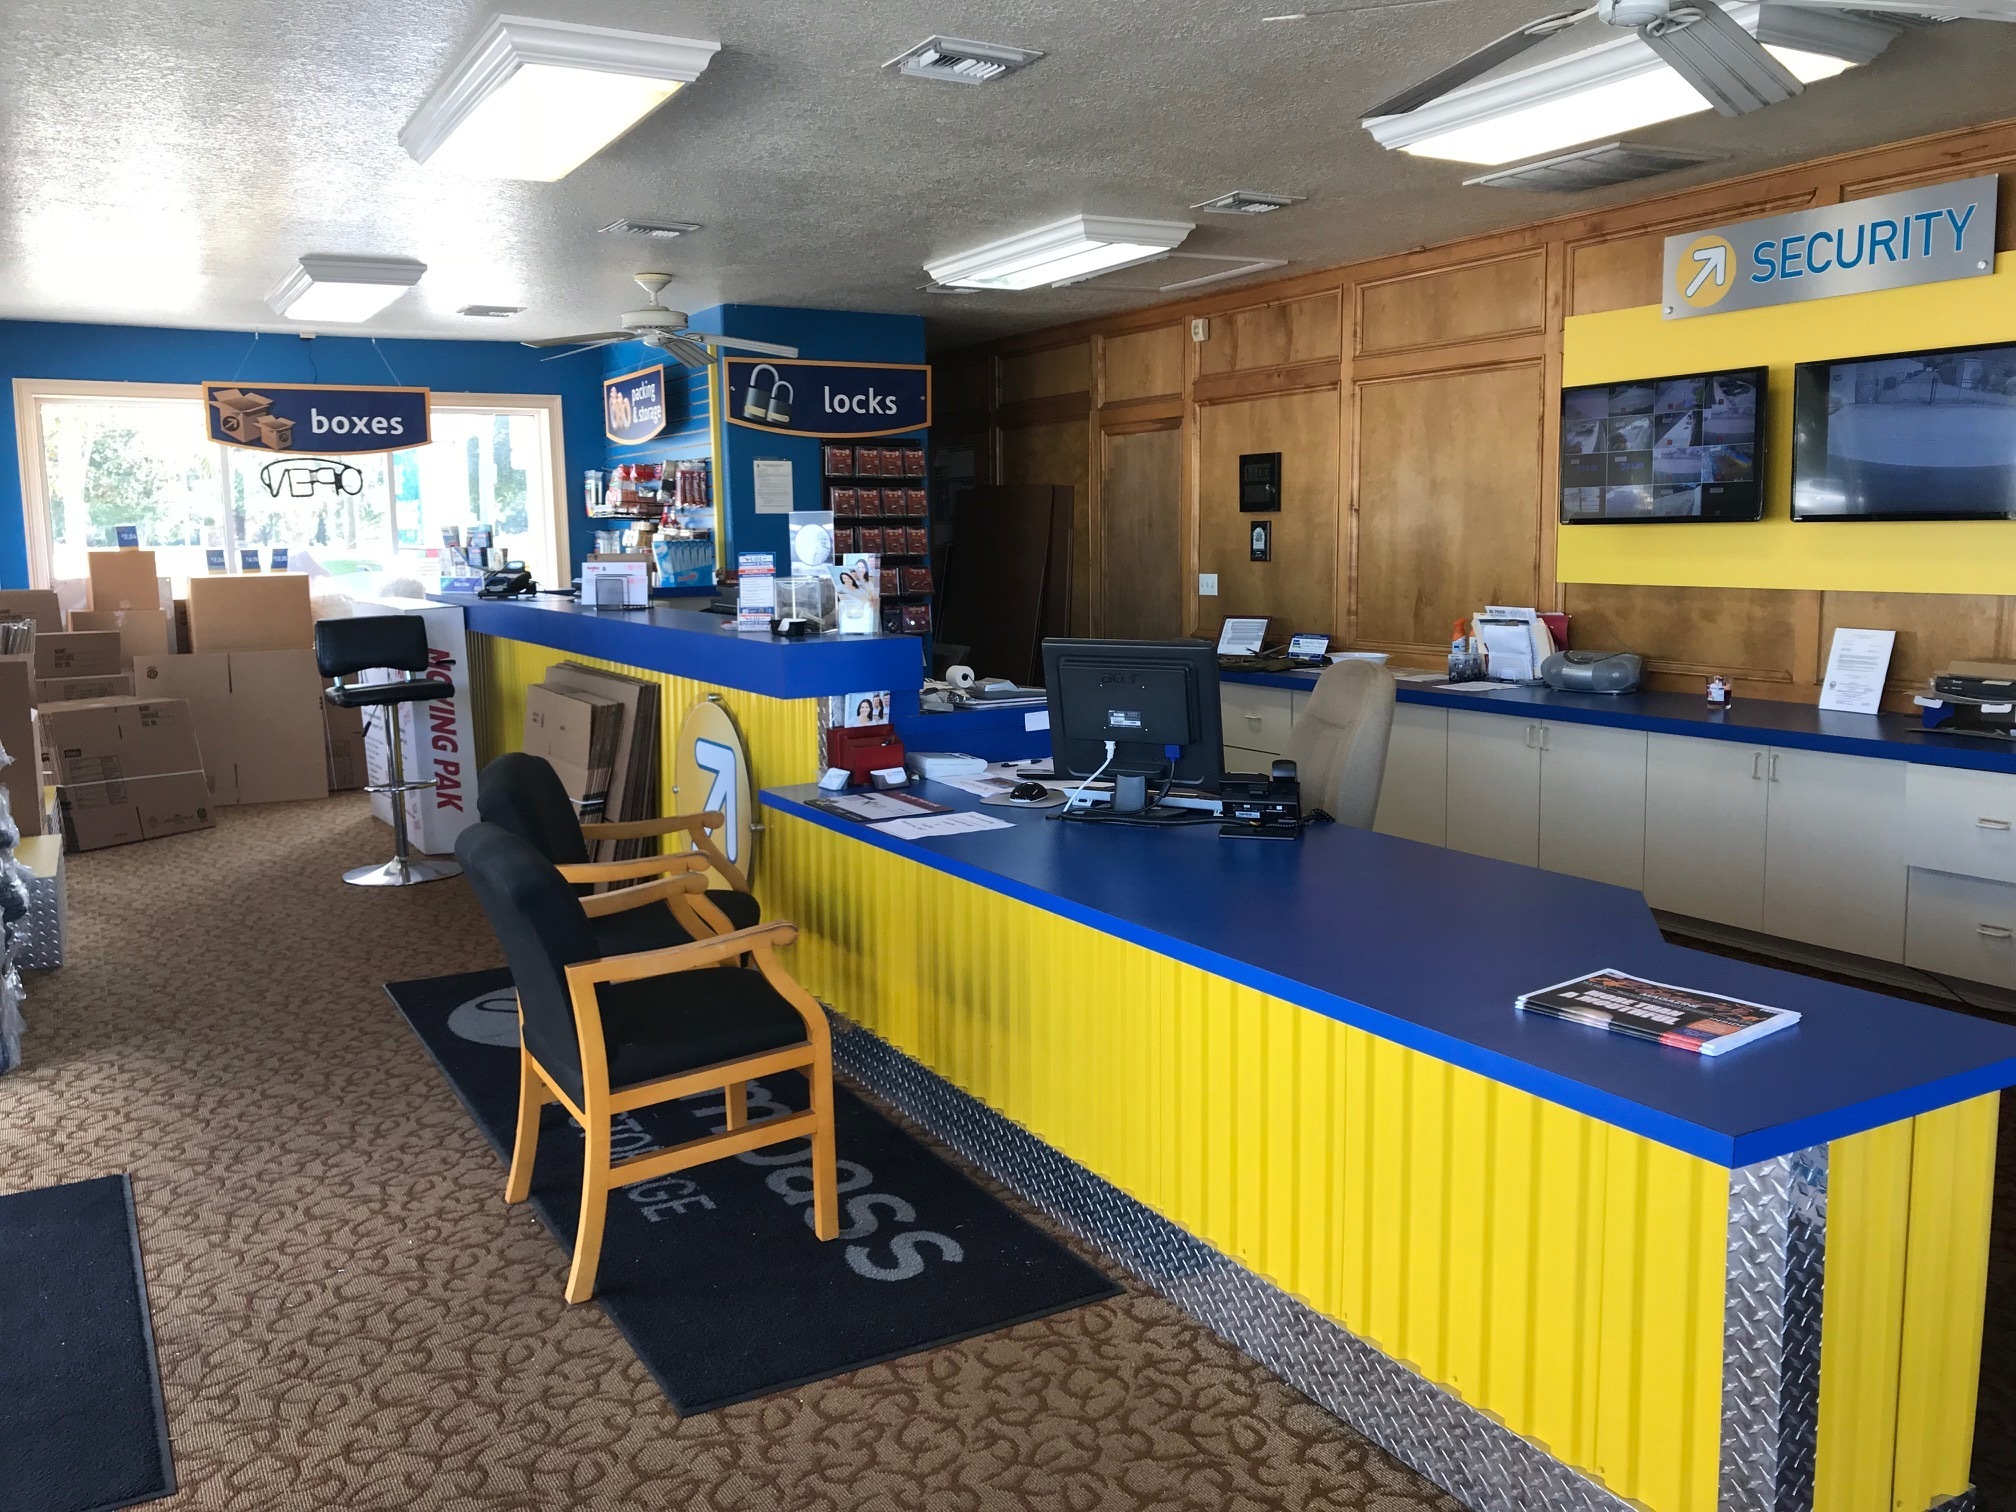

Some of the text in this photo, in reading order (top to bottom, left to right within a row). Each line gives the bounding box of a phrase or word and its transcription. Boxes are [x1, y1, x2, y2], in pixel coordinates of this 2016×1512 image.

[1749, 202, 1979, 284] SECURITY
[631, 380, 656, 407] packing
[824, 385, 898, 415] locks
[311, 408, 404, 436] boxes
[633, 405, 662, 424] & storage
[1101, 671, 1141, 686] acer
[433, 758, 464, 813] PAK
[1574, 995, 1681, 1025] MOUTHFUL
[1583, 990, 1638, 1006] MORE
[1634, 1002, 1686, 1017] THAN
[1709, 1017, 1745, 1028] INSIDE
